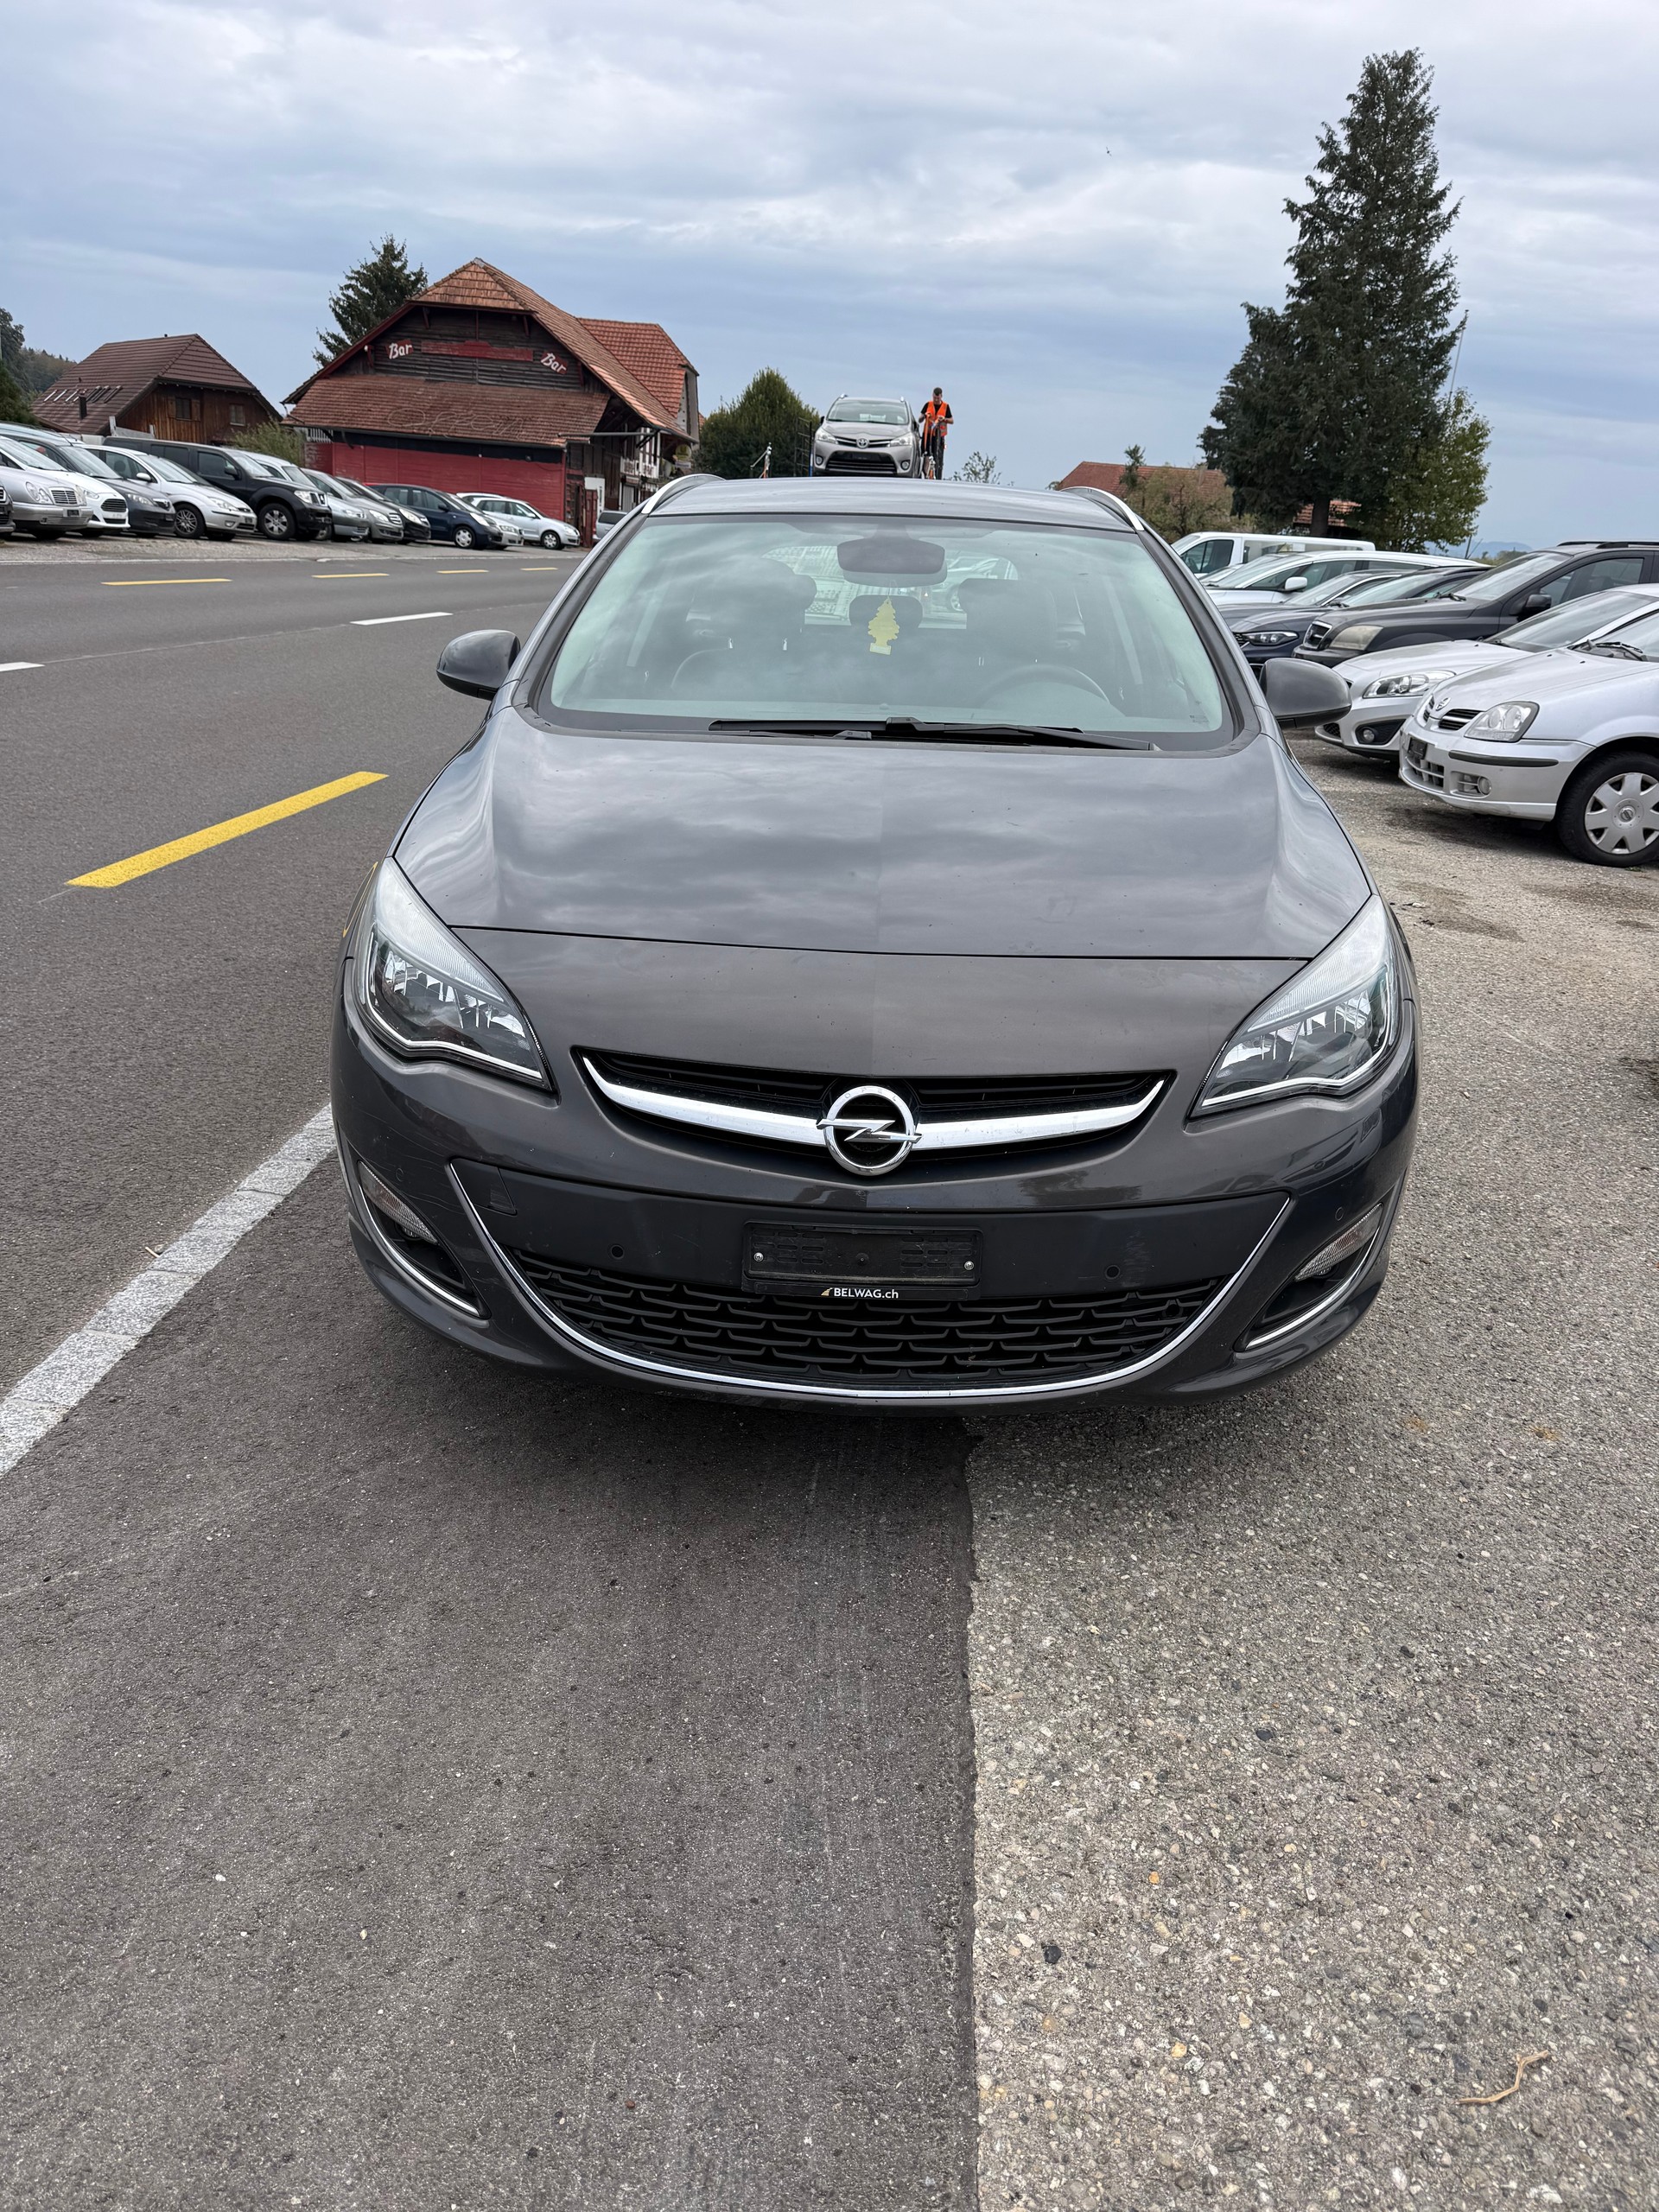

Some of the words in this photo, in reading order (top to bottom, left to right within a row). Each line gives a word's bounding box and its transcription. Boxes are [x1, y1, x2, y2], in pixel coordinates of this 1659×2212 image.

[389, 342, 412, 359] Bar
[540, 353, 567, 372] Bar
[844, 1086, 896, 1102] OPEL
[834, 1287, 899, 1299] BELWAG.ch
